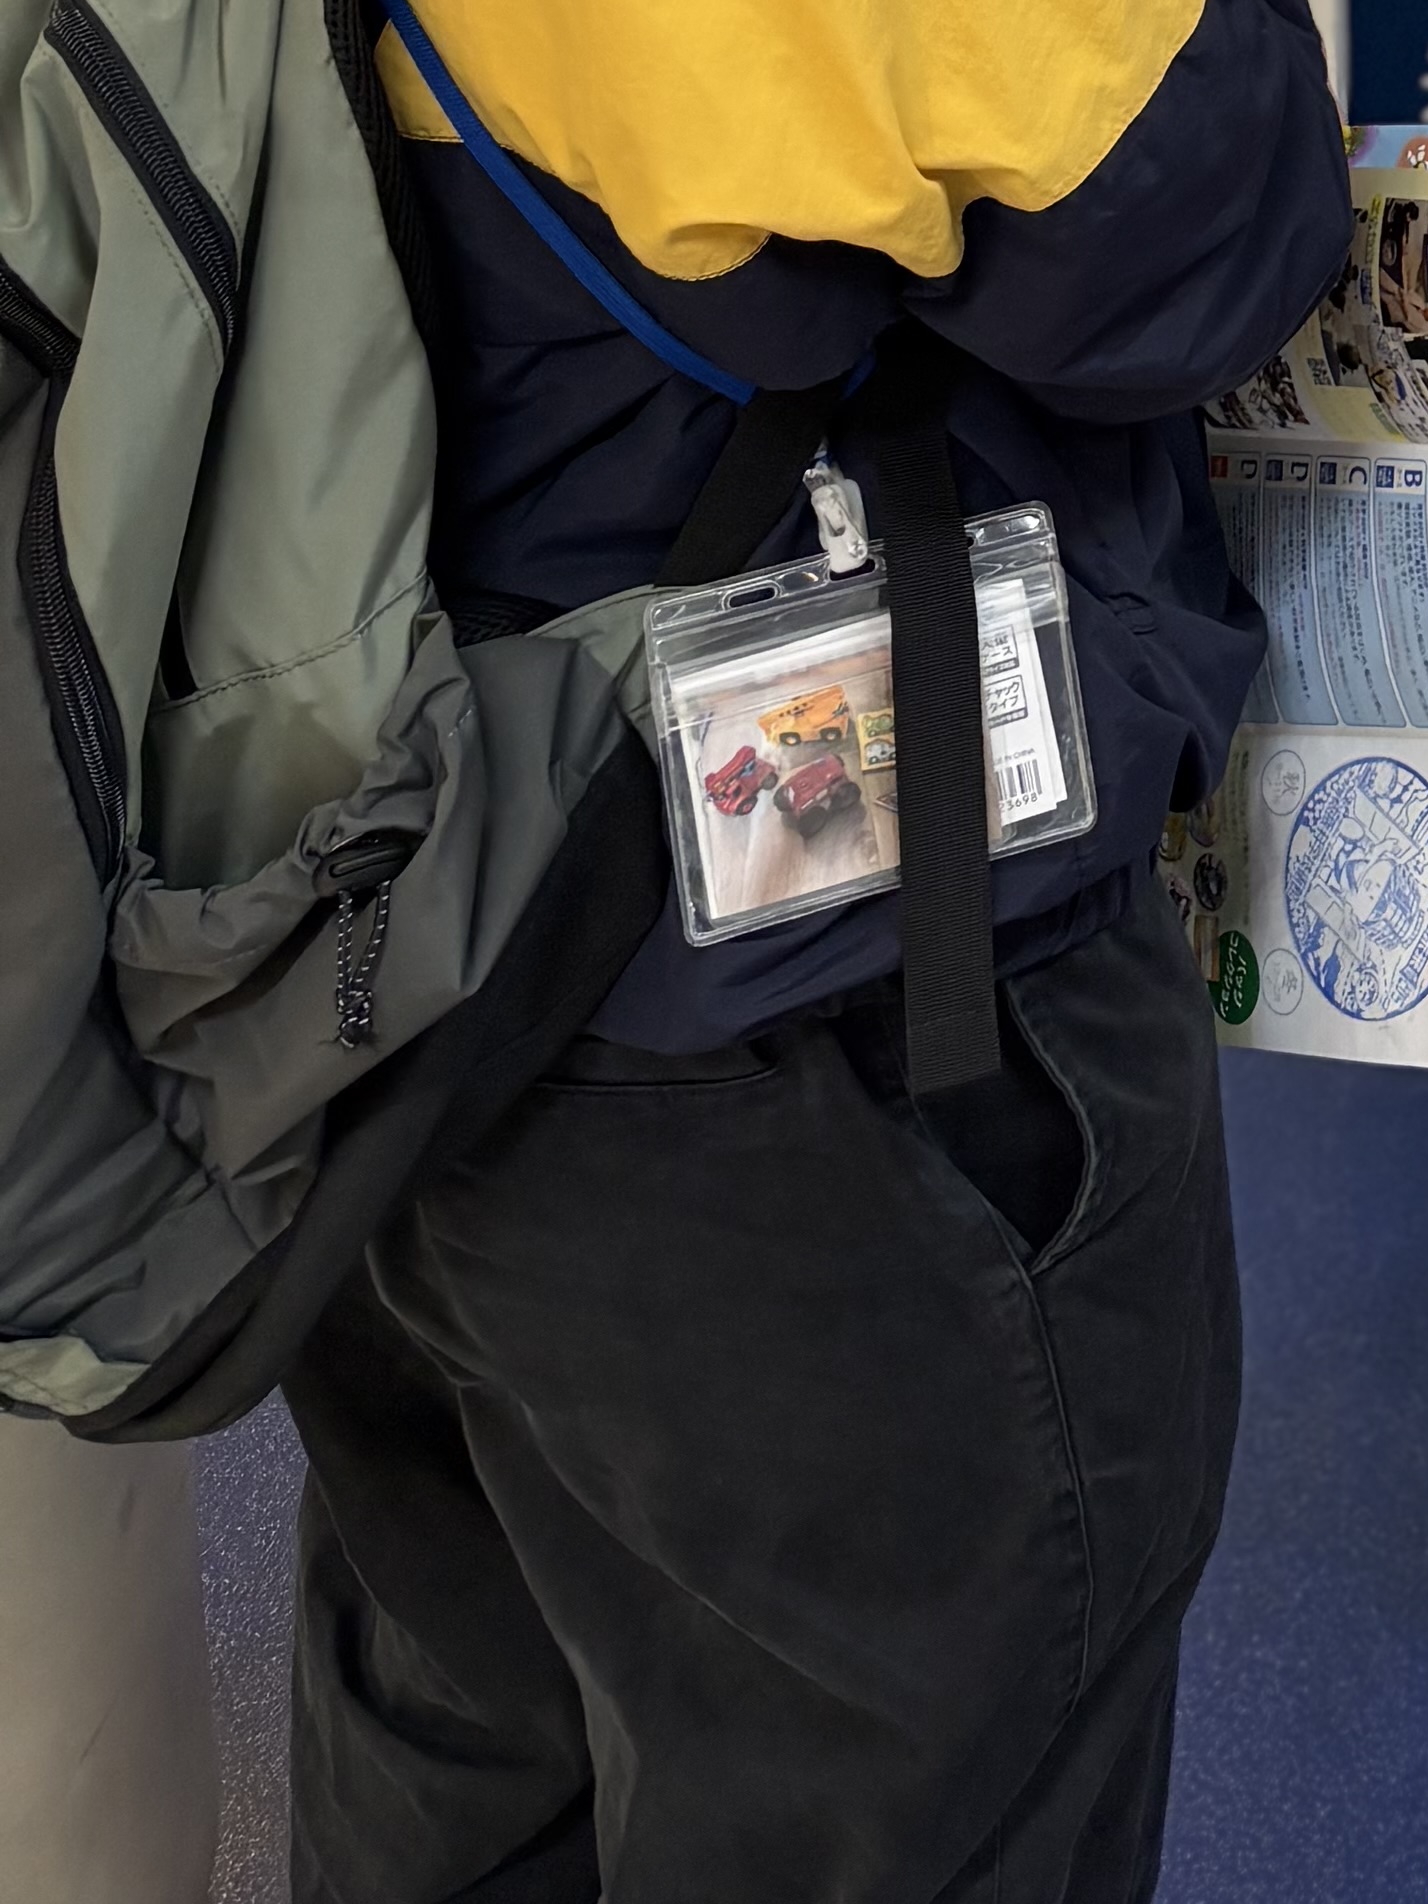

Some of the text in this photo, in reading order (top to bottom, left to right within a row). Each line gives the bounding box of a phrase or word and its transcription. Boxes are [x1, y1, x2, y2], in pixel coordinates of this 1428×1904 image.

[1348, 466, 1367, 485] C
[1404, 469, 1422, 487] B
[1281, 772, 1300, 796] 秋
[1281, 969, 1298, 991] 冬
